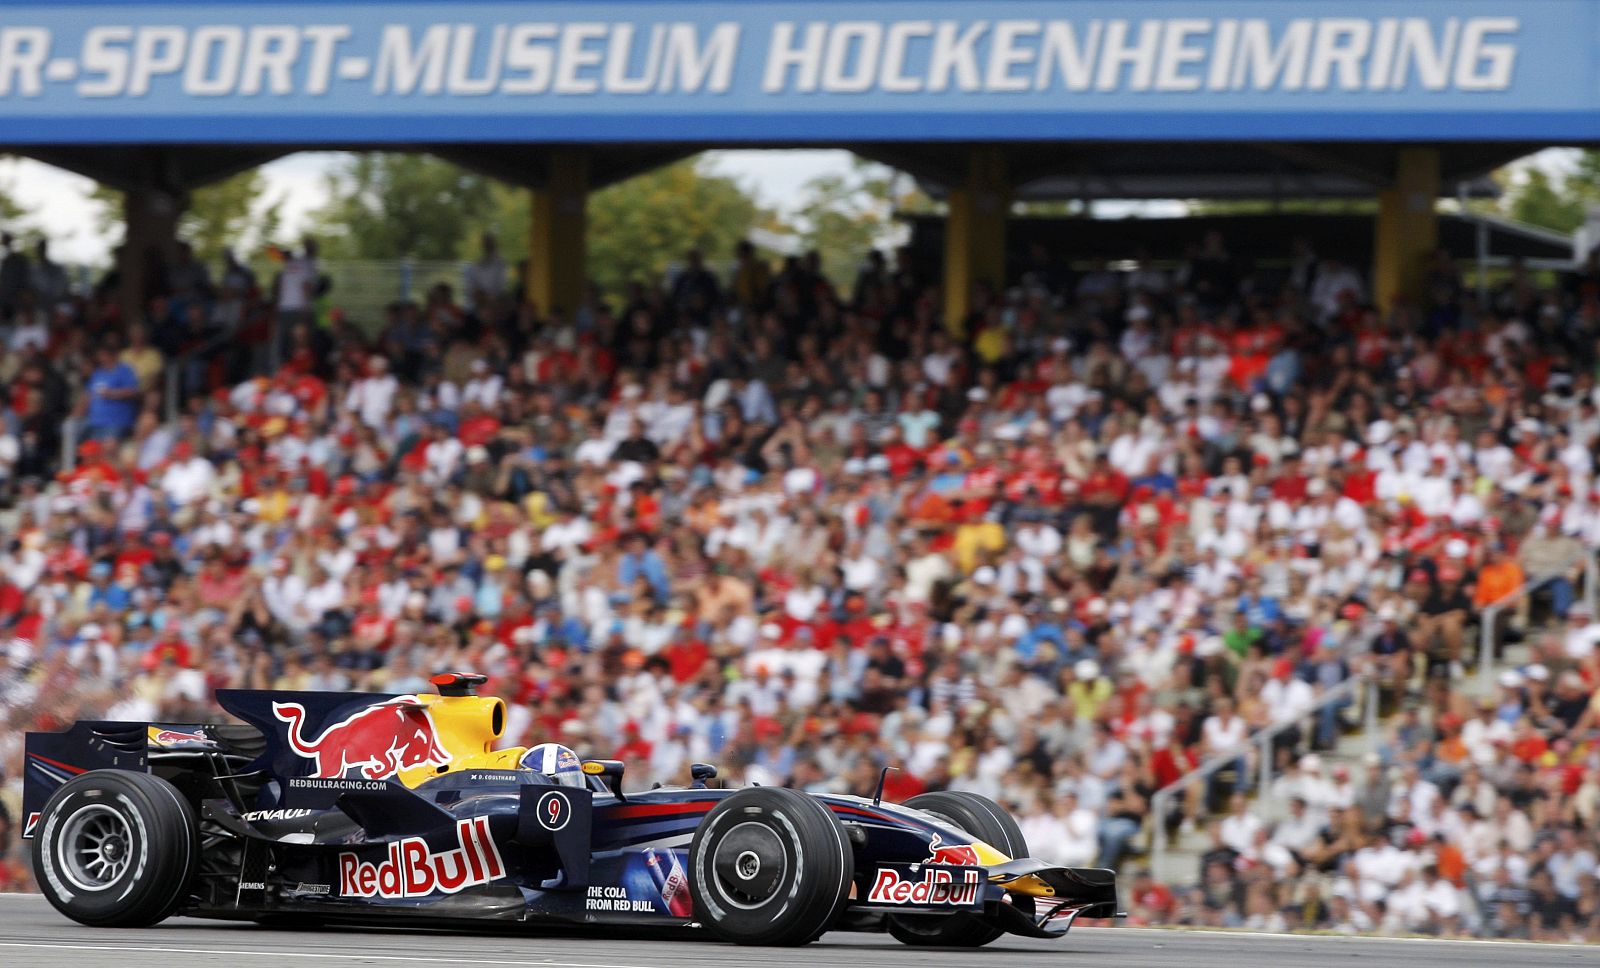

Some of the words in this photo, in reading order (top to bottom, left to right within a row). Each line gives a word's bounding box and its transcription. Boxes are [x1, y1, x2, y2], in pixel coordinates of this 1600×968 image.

[0, 23, 741, 97] R-SPORT-MUSEUM
[761, 17, 1520, 93] HOCKENHEIMRING
[289, 779, 387, 791] REDBULLRACING.COM
[547, 798, 561, 824] 9
[238, 882, 265, 890] SIEMENS
[604, 887, 627, 899] COLA
[586, 899, 612, 911] FROM
[614, 900, 631, 911] RED
[632, 901, 656, 912] BULL.
